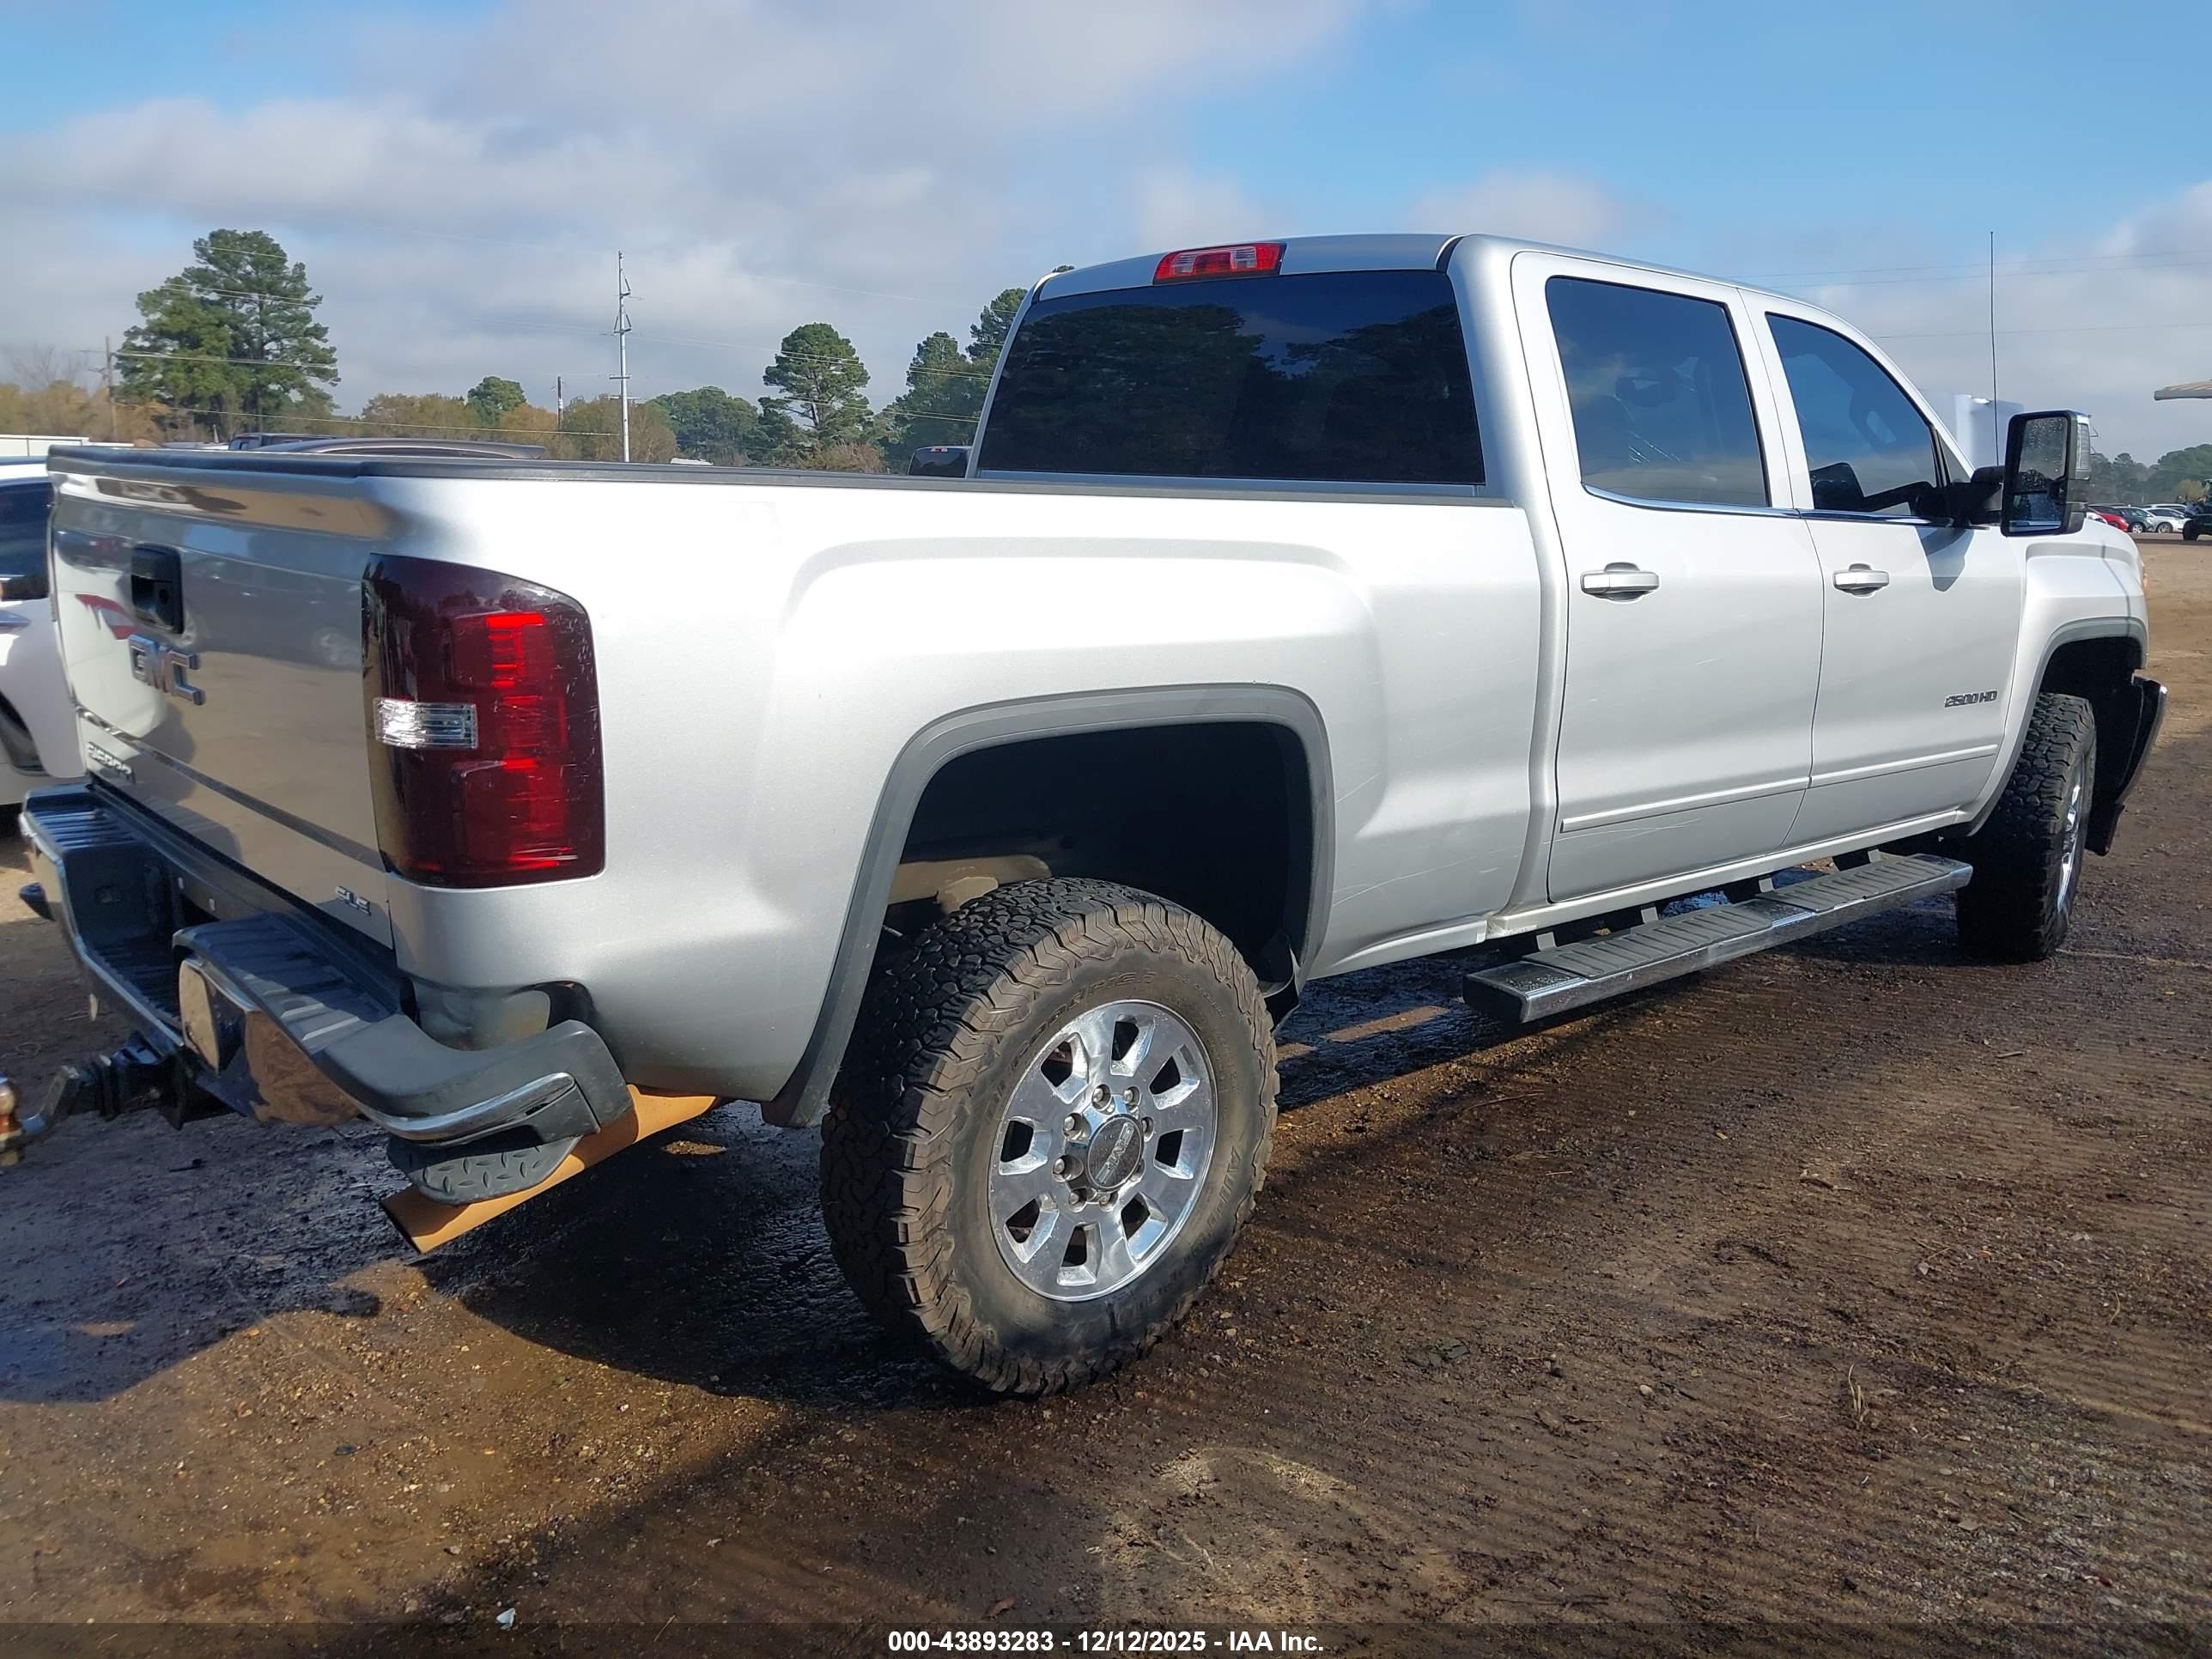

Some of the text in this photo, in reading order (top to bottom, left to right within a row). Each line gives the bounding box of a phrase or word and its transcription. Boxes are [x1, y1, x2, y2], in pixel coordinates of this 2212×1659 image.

[128, 634, 206, 706] GMC
[1944, 690, 1998, 708] 2500 HD
[1095, 1121, 1134, 1184] GMC
